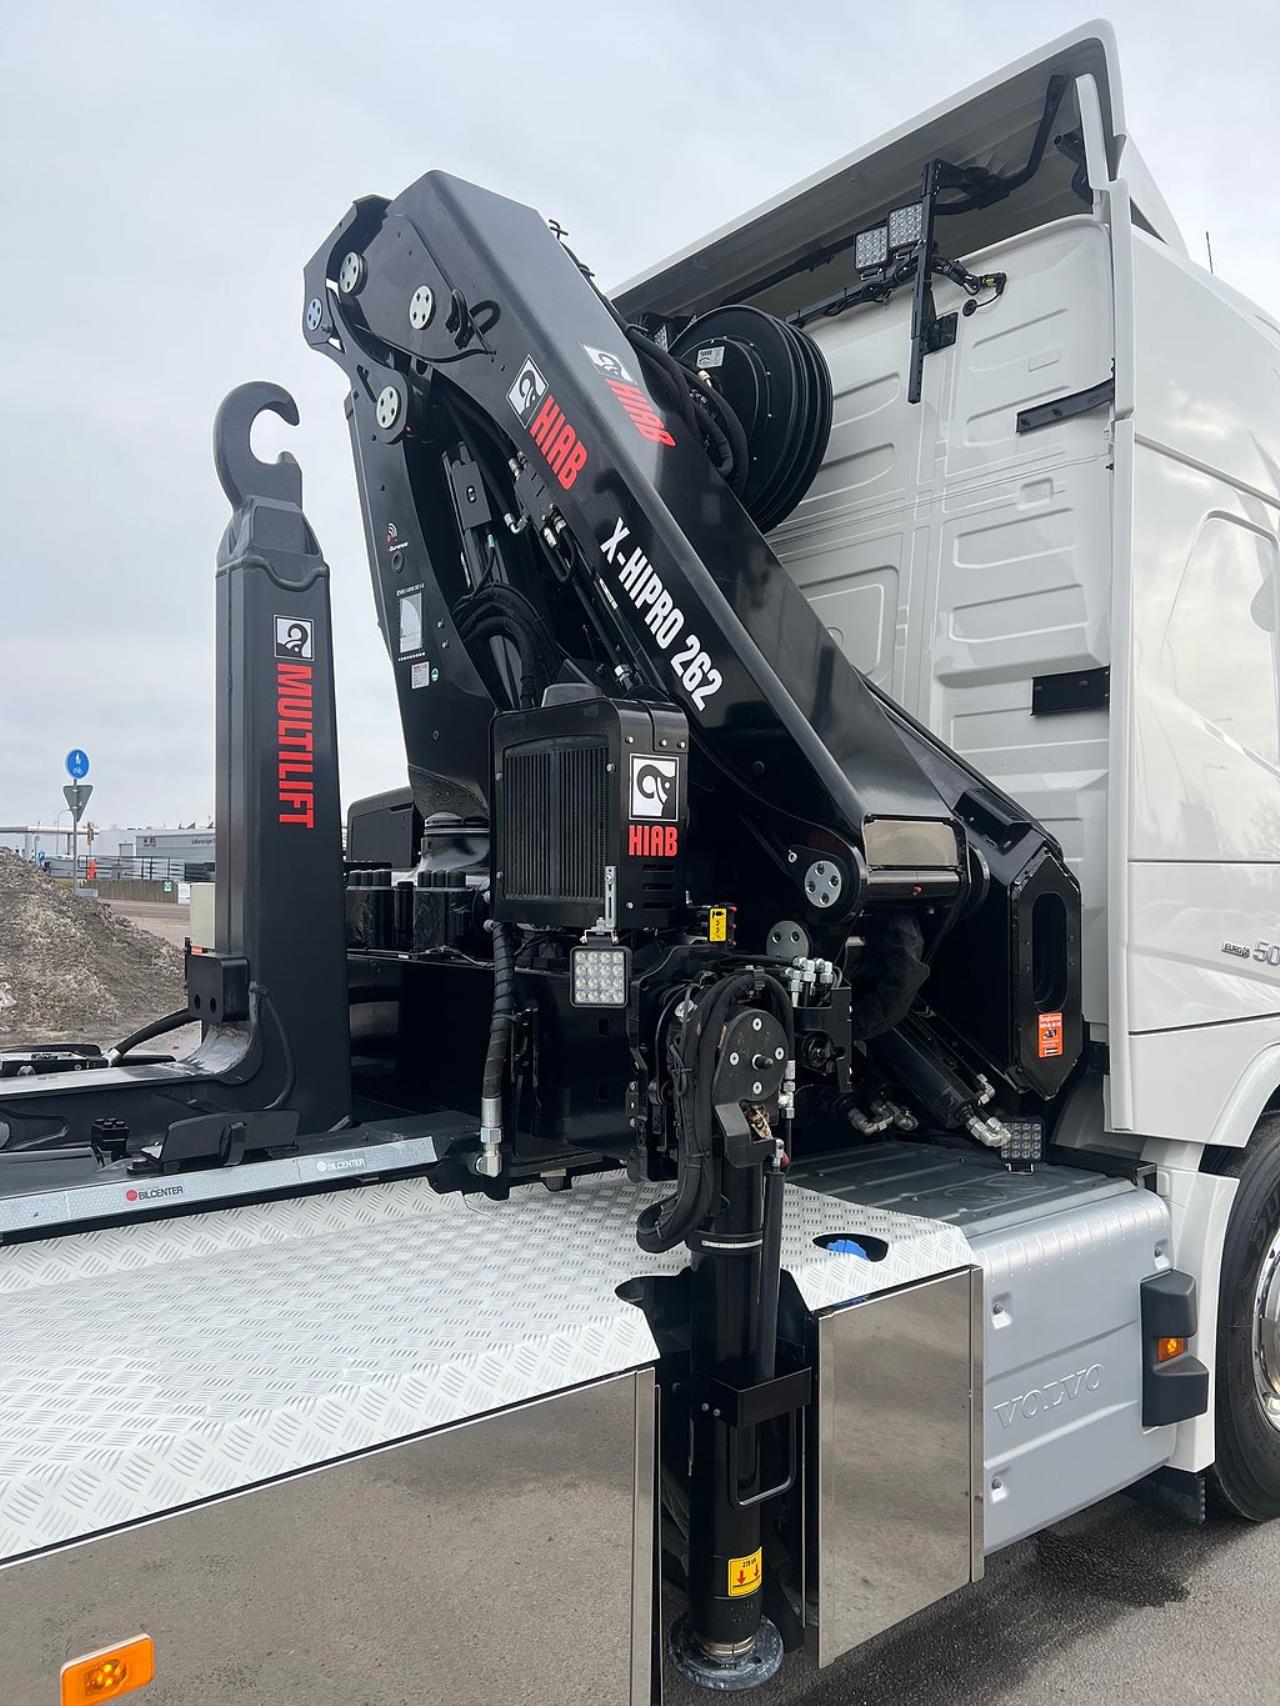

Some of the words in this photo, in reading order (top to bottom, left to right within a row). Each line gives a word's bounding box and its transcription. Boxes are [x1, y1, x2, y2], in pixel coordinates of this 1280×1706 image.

[529, 395, 588, 491] HIAB
[605, 378, 676, 447] HIAB
[600, 516, 684, 650] X-HIPRO
[670, 634, 723, 712] 262
[277, 663, 314, 829] MULTILIFT
[628, 824, 678, 857] HIAB
[138, 1185, 184, 1201] BILCENTER
[992, 1363, 1104, 1430] VOLVO
